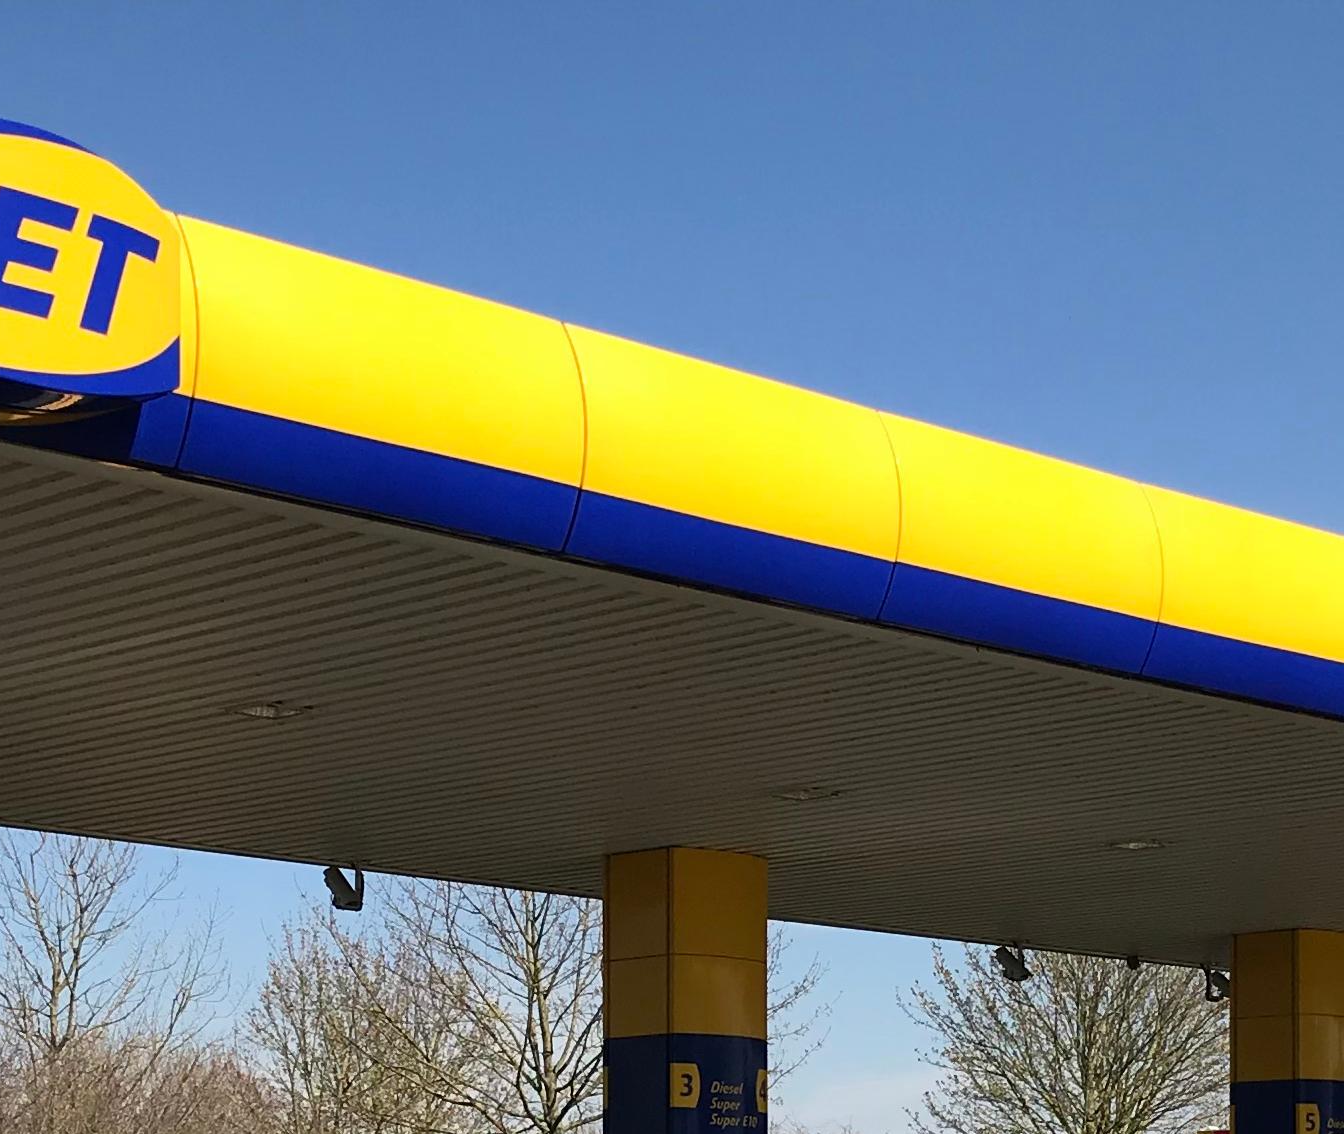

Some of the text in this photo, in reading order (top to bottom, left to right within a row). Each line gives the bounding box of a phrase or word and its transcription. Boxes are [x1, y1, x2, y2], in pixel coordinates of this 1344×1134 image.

[680, 1073, 693, 1096] 3
[710, 1081, 744, 1094] Diesel
[710, 1097, 740, 1112] Super
[709, 1113, 758, 1129] Super E10
[1305, 1112, 1315, 1131] 5
